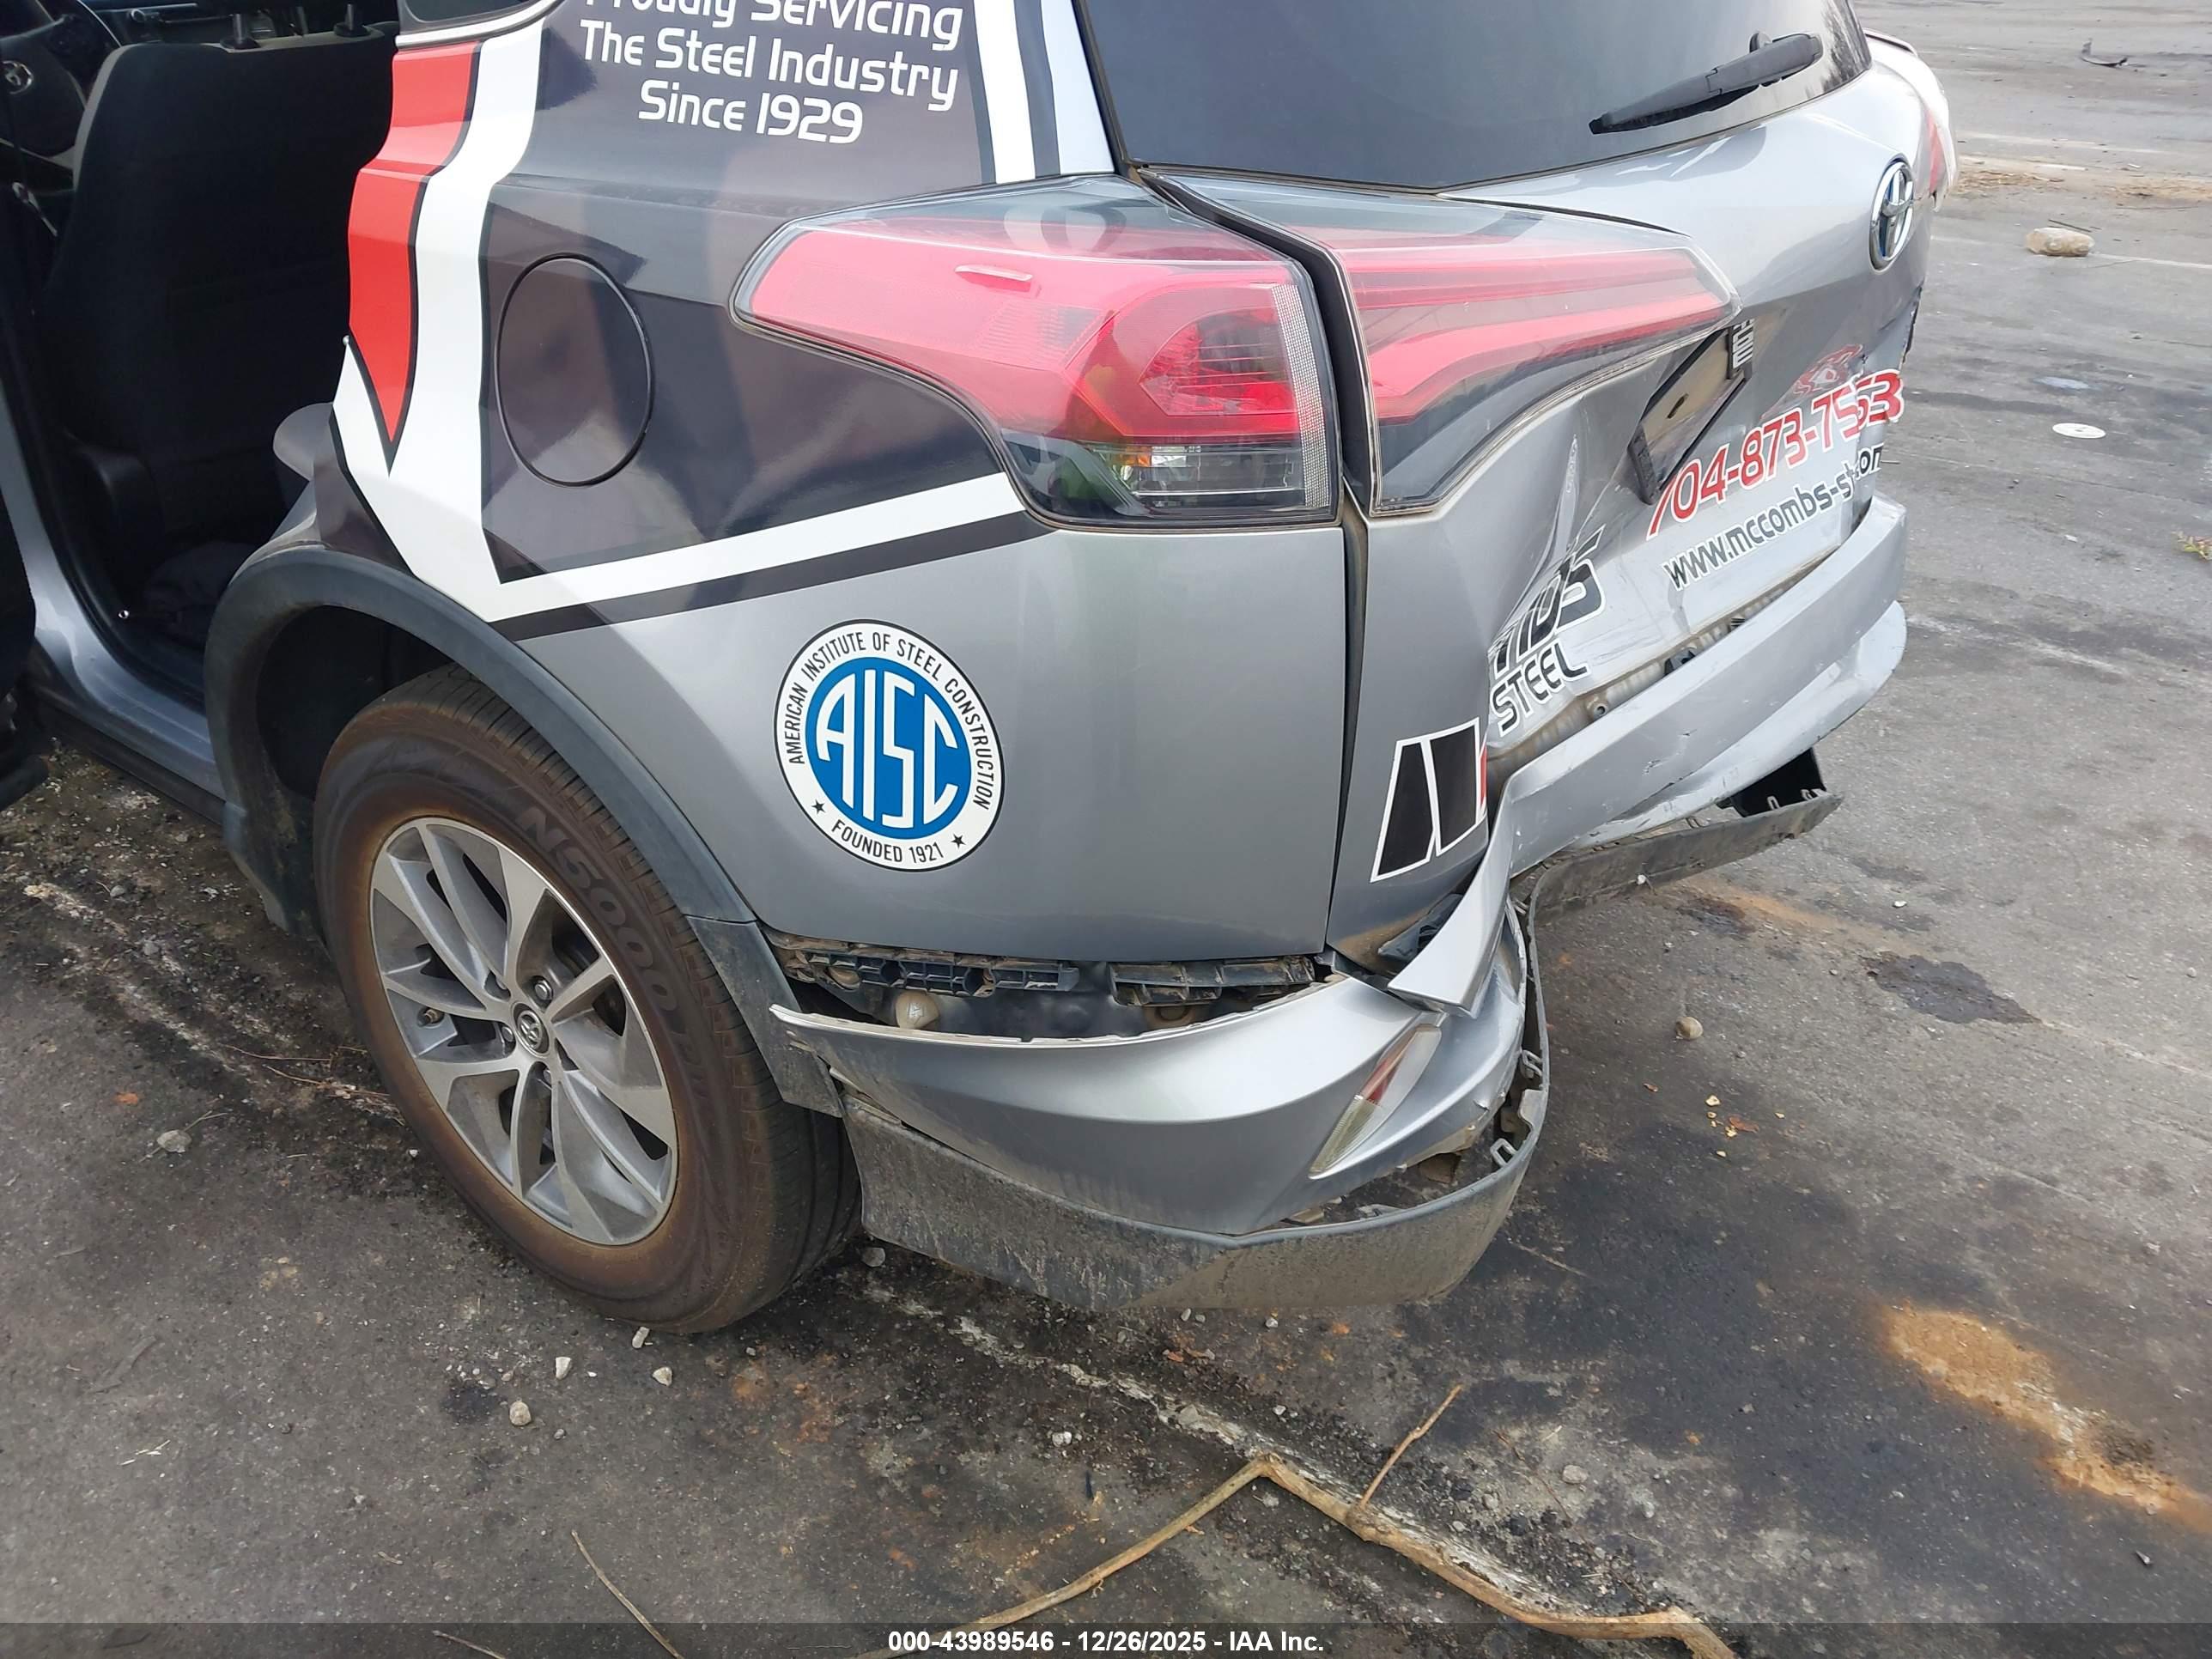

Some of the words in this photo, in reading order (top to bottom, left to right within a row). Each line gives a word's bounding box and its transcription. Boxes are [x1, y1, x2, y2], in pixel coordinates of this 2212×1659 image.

[580, 20, 645, 66] The
[654, 27, 757, 78] Steel
[768, 38, 959, 112] Industry
[638, 79, 746, 132] Since
[756, 92, 864, 144] 1929
[784, 681, 809, 765] AMERICAN
[801, 631, 866, 682] INSTITUTE
[872, 631, 891, 652] OF
[896, 638, 943, 681] STEEL
[945, 678, 994, 810] CONSTRUCTION
[1492, 641, 1589, 736] STEEL
[816, 668, 959, 829] AISC
[831, 819, 903, 863] FOUNDED
[908, 842, 945, 864] 1921
